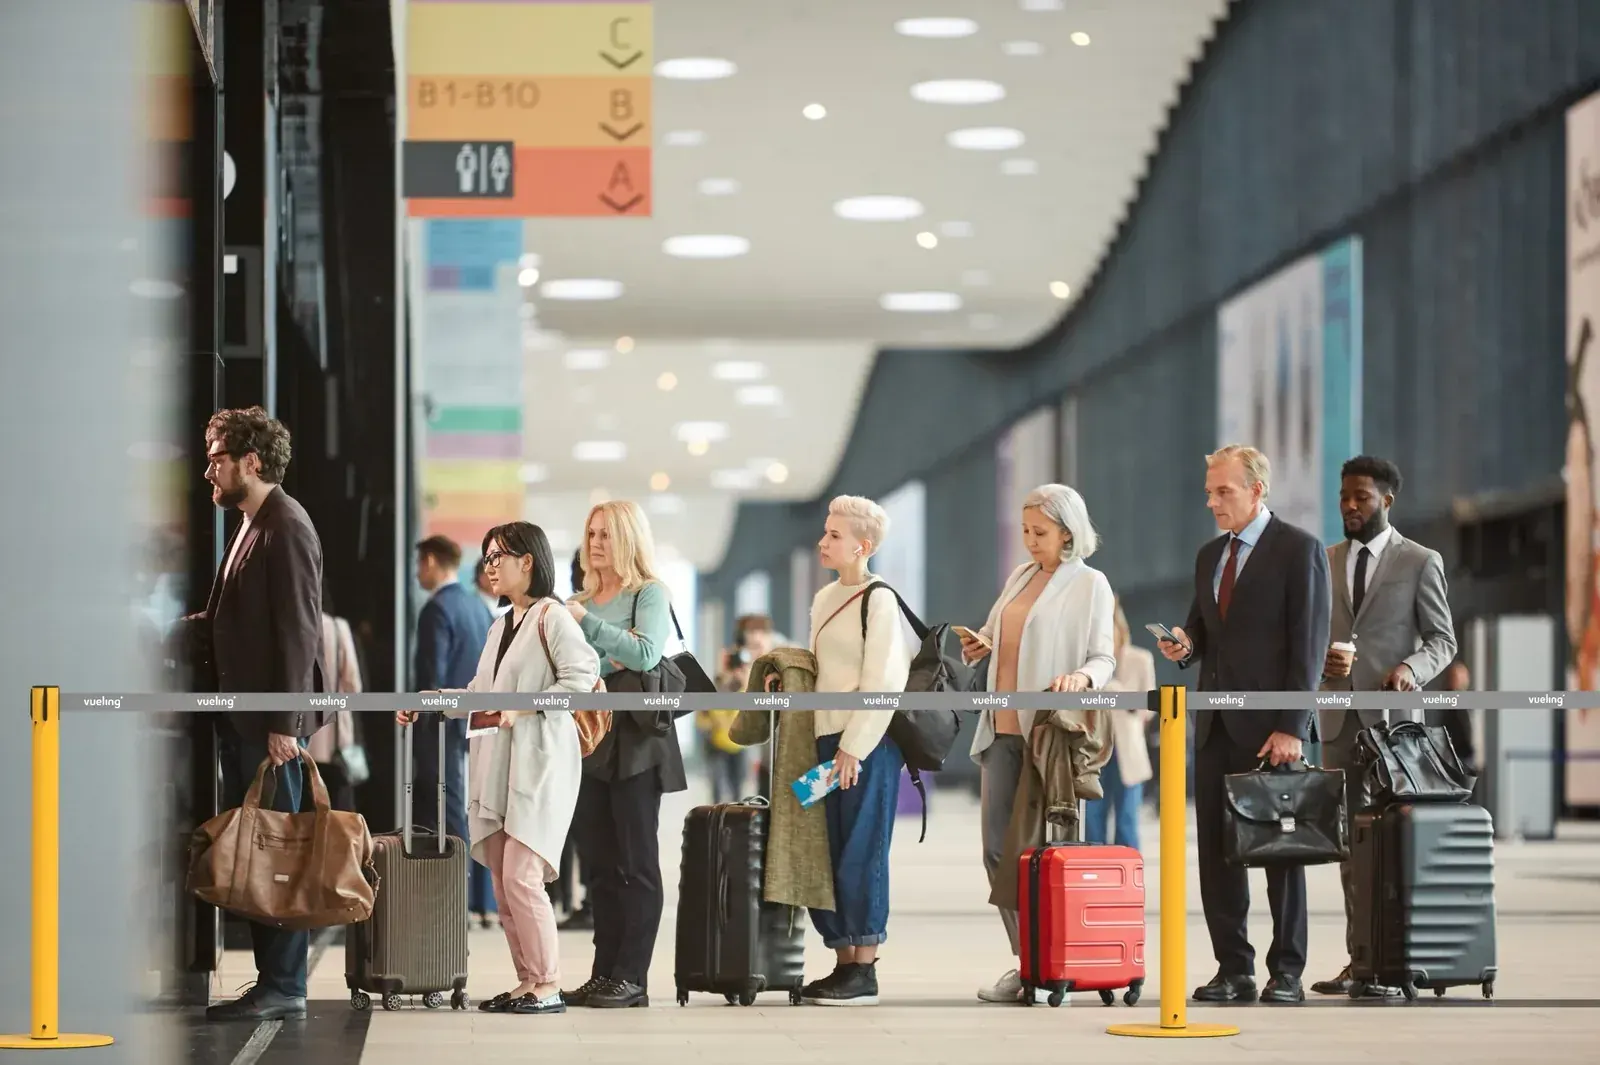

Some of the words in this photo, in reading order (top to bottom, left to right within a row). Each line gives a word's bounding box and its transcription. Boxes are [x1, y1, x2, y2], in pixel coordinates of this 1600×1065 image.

[609, 16, 632, 50] C
[609, 88, 633, 121] B
[607, 159, 634, 192] A
[83, 695, 122, 709] vueling
[196, 695, 236, 709] vueling
[308, 694, 348, 709] vueling
[420, 694, 460, 709] vueling
[532, 694, 571, 709] vueling
[642, 694, 681, 709] vueling
[752, 694, 791, 709] vueling
[862, 693, 901, 709] vueling
[972, 693, 1010, 709] vueling
[1080, 693, 1118, 708] vueling
[1208, 693, 1246, 708] vueling
[1315, 693, 1353, 708] vueling
[1421, 693, 1459, 708] vueling
[1527, 693, 1566, 708] vueling
